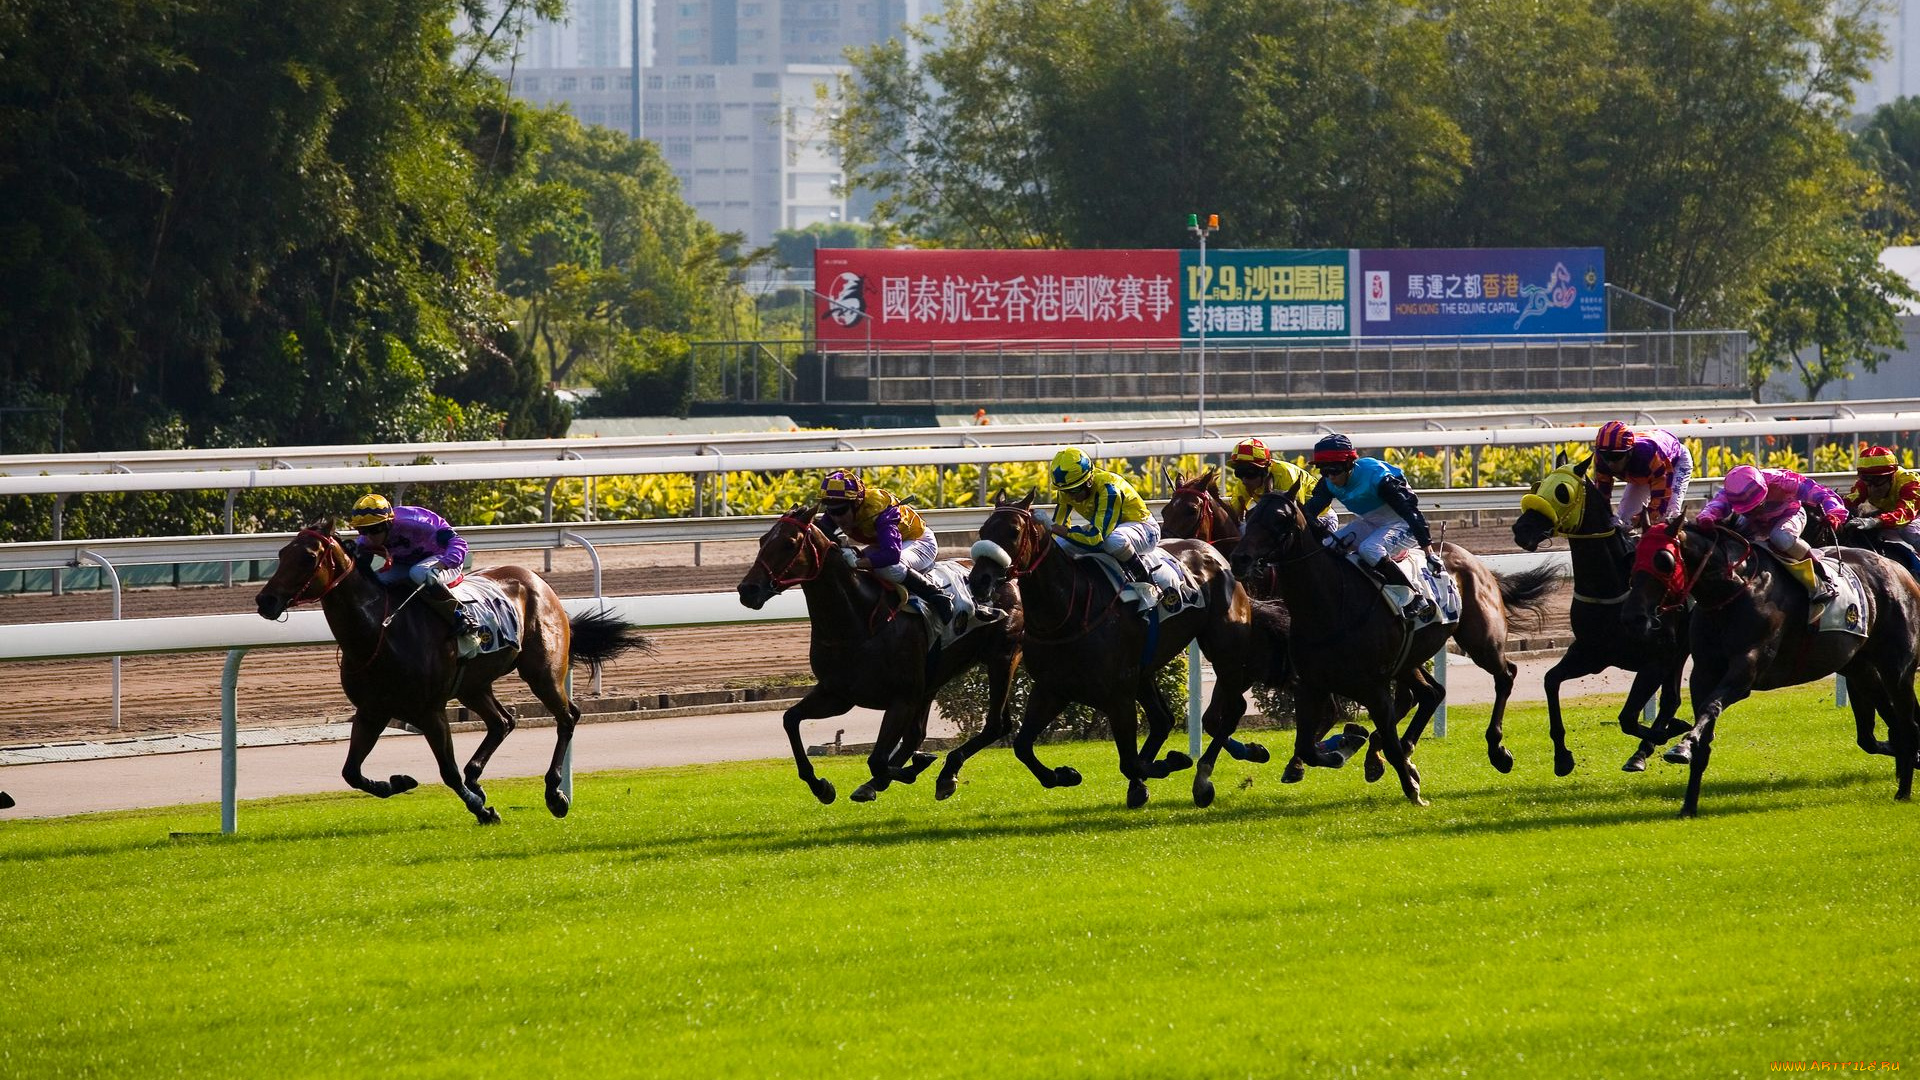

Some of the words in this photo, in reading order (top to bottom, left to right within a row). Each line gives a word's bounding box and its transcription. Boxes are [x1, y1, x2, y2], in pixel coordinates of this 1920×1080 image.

[882, 274, 1174, 324] 國泰航空香港國際賽事
[1407, 273, 1519, 299] 馬運之都香港
[1187, 305, 1264, 332] 支持香港
[1270, 304, 1345, 331] 跑到最前
[1395, 304, 1418, 316] HONG
[1419, 303, 1439, 315] KONG
[1441, 303, 1457, 315] THE
[1458, 303, 1486, 314] EQUINE
[1488, 302, 1520, 314] CAPITAL
